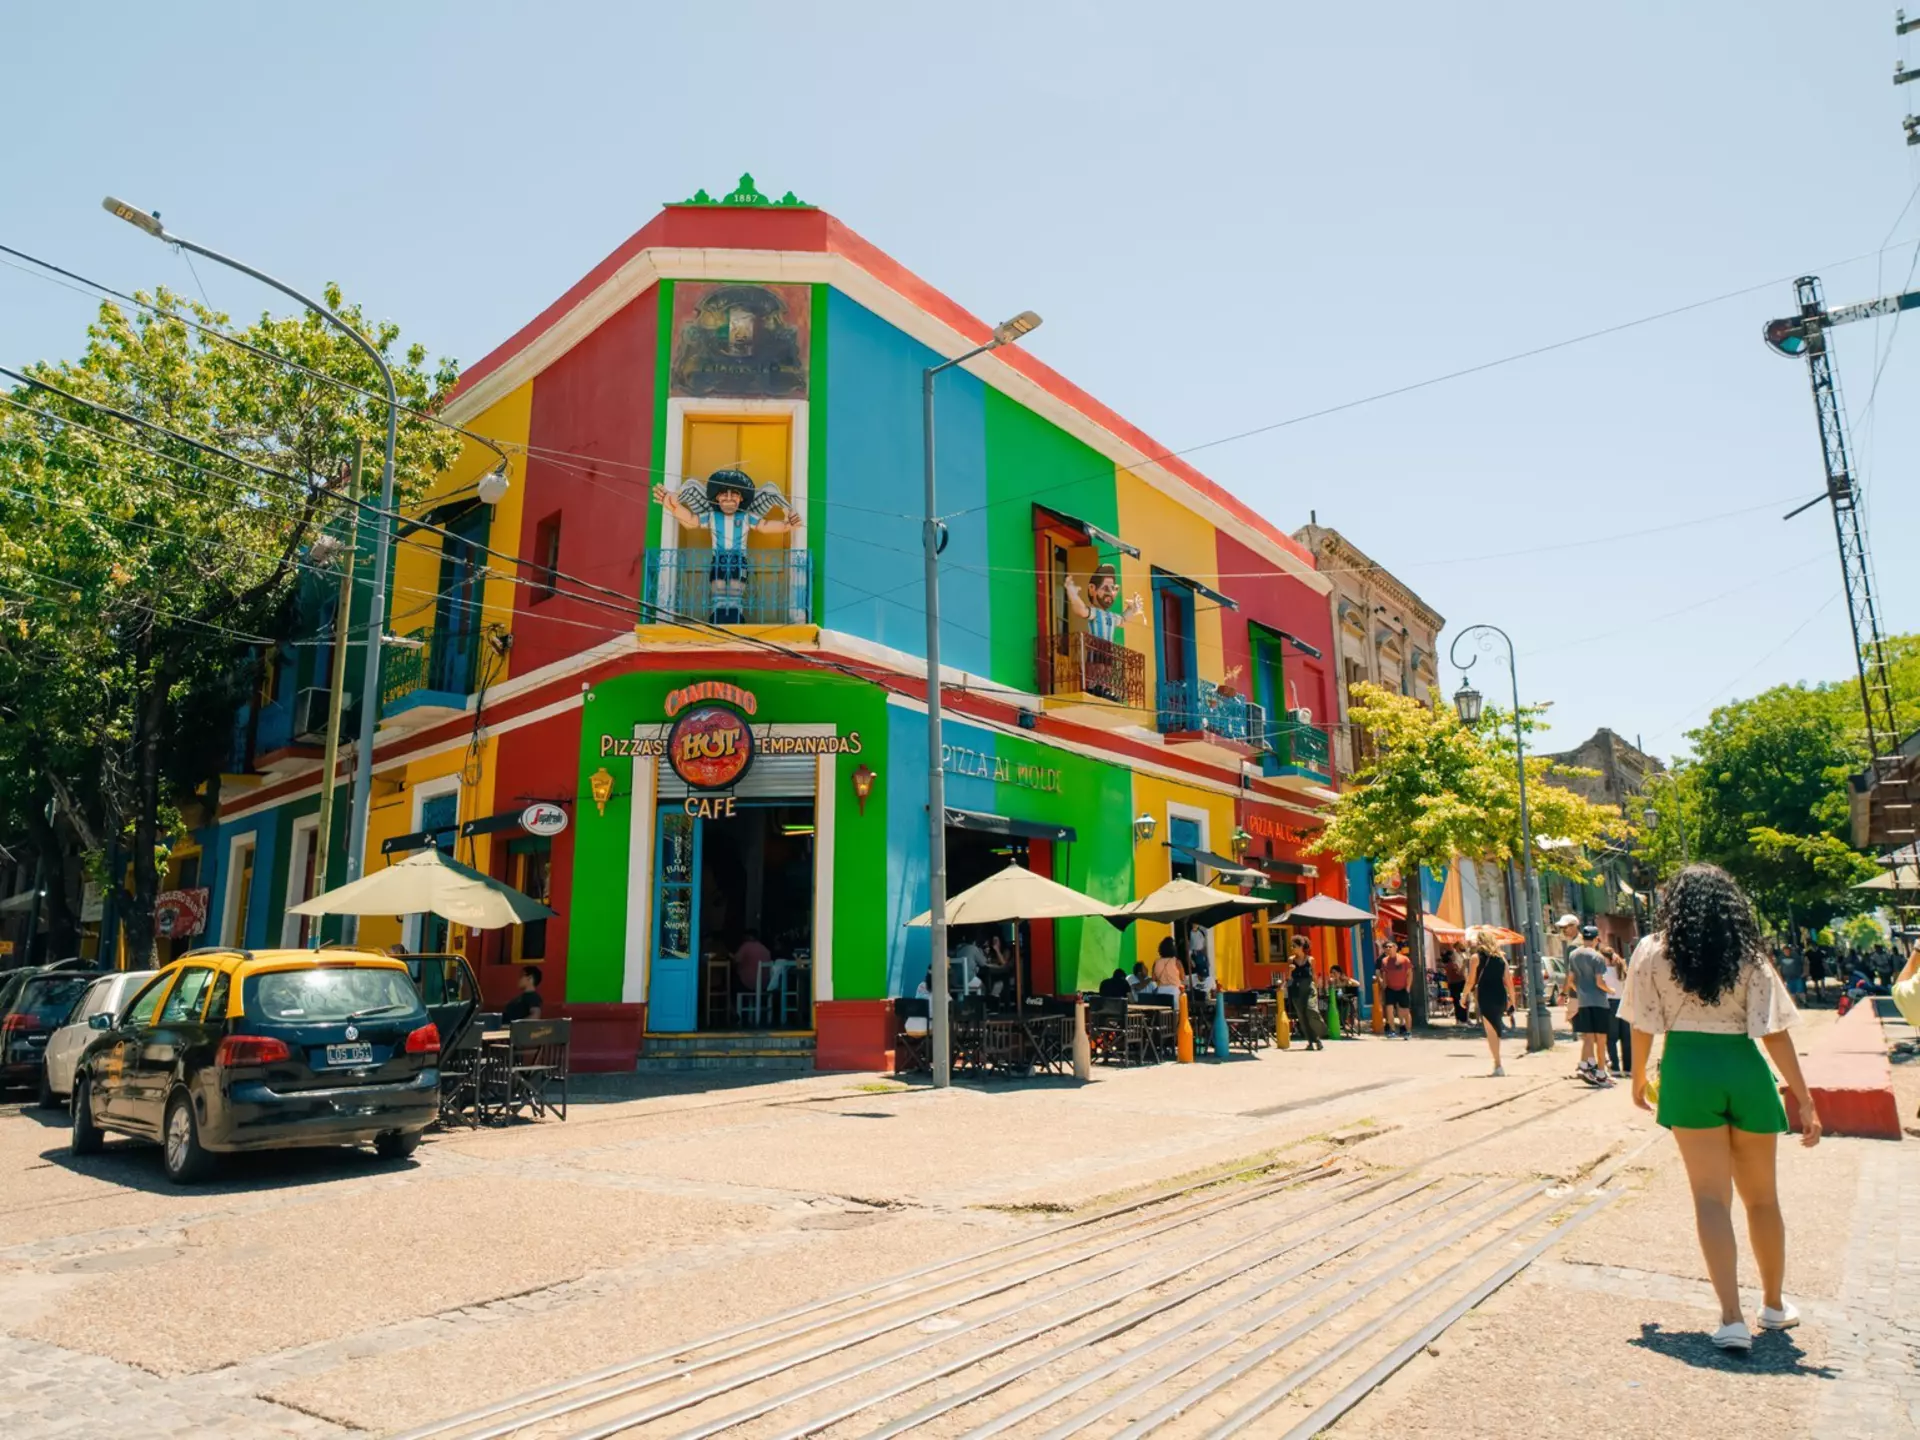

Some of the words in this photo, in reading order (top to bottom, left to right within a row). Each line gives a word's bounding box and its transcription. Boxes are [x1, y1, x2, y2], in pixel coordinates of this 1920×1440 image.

[733, 194, 758, 203] 1887
[600, 734, 663, 757] PIZZAS
[761, 732, 862, 754] EMPANADAS
[941, 744, 989, 778] PIZZA
[684, 797, 737, 819] CAFE
